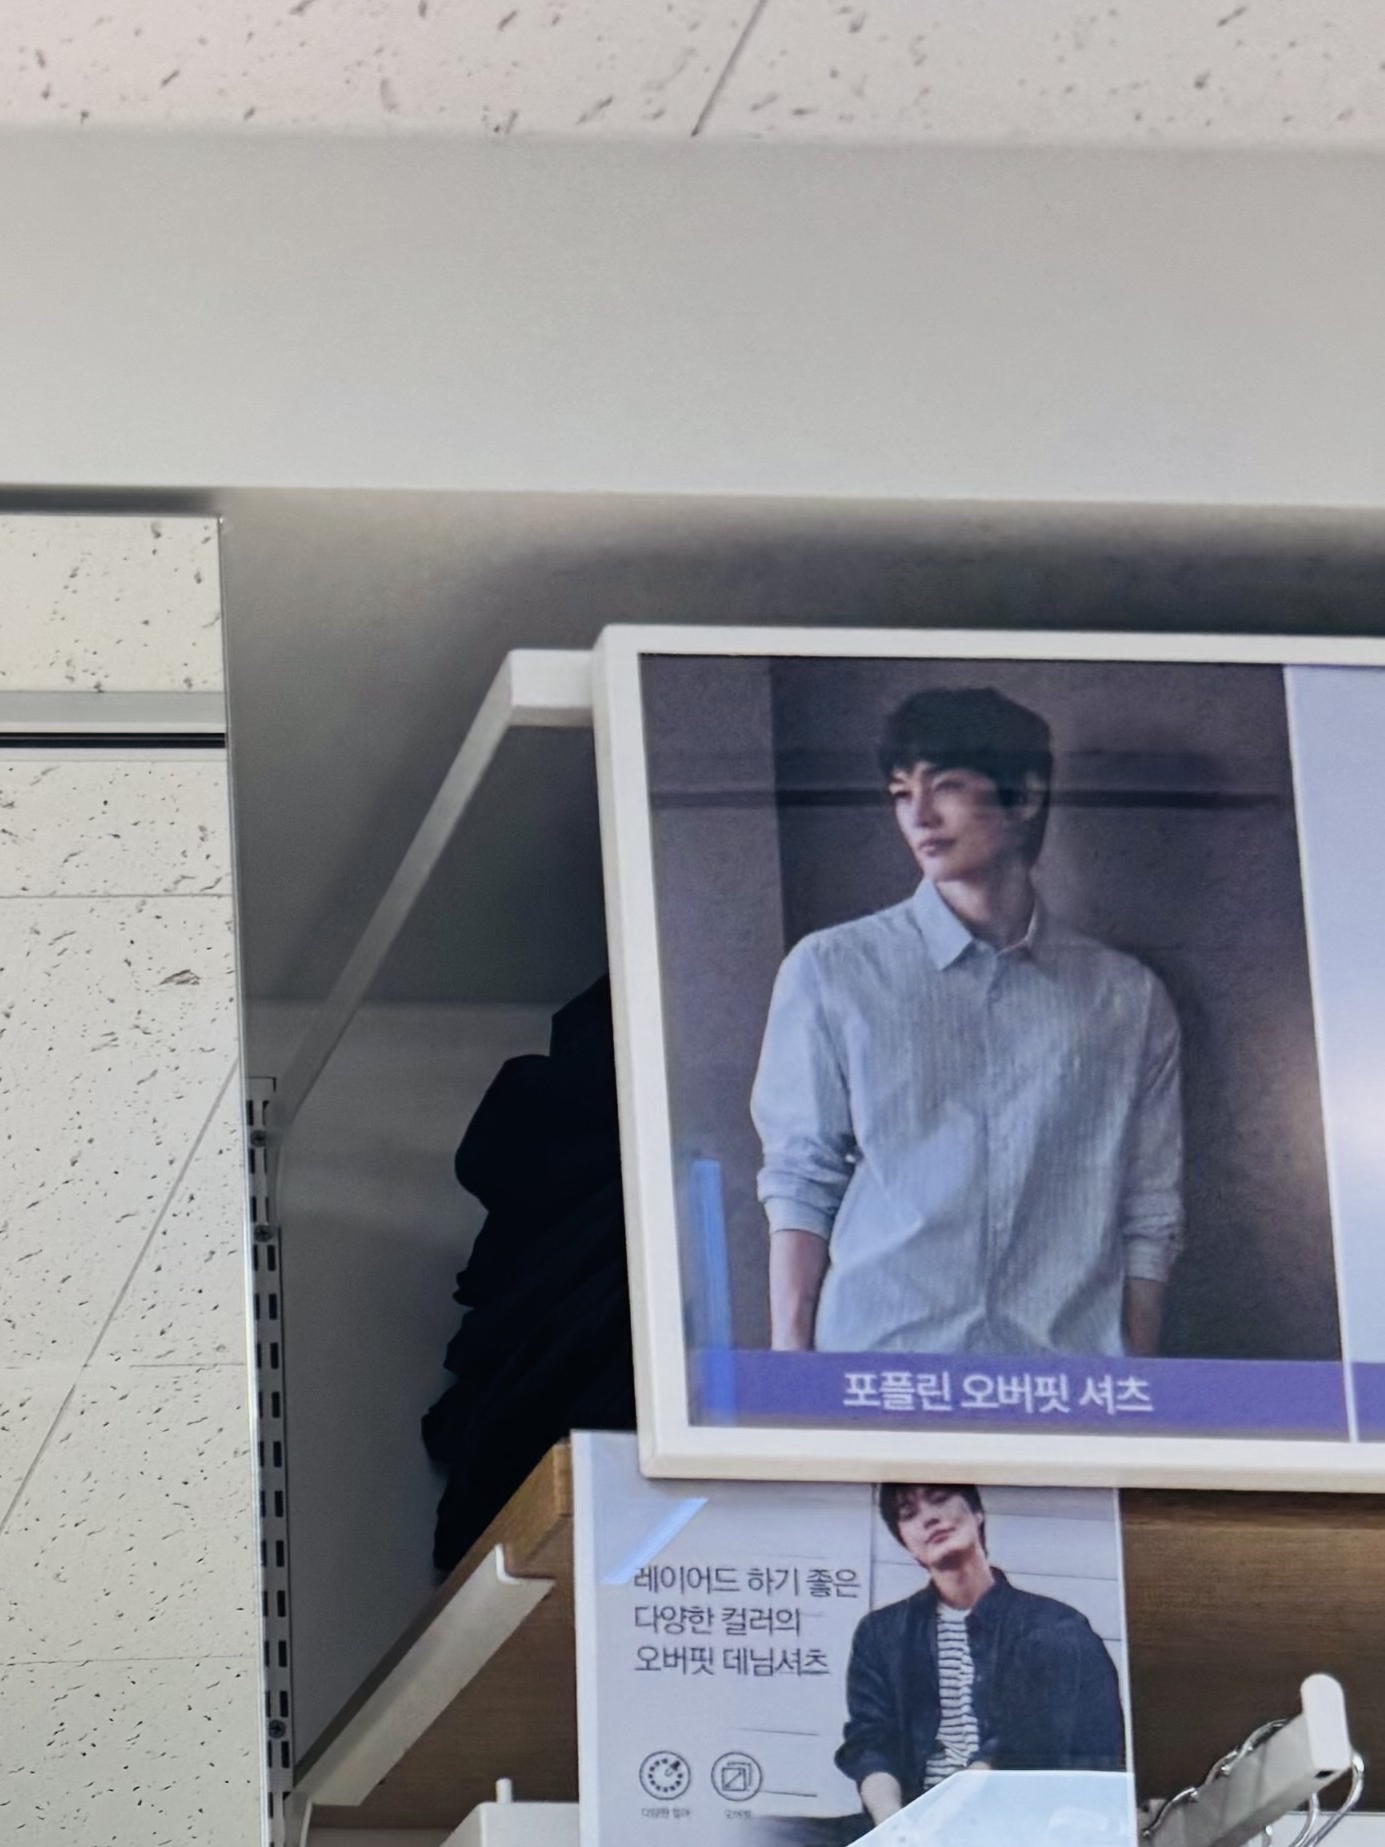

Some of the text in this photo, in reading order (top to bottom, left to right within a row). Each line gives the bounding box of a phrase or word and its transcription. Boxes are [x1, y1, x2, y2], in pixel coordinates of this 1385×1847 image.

[843, 1371, 1154, 1414] 포플린 오버핏 셔츠
[633, 1565, 861, 1599] 레이어드 하기 좋은
[634, 1605, 801, 1636] 다양한 컬러의
[634, 1645, 830, 1677] 오버핏 데님셔츠
